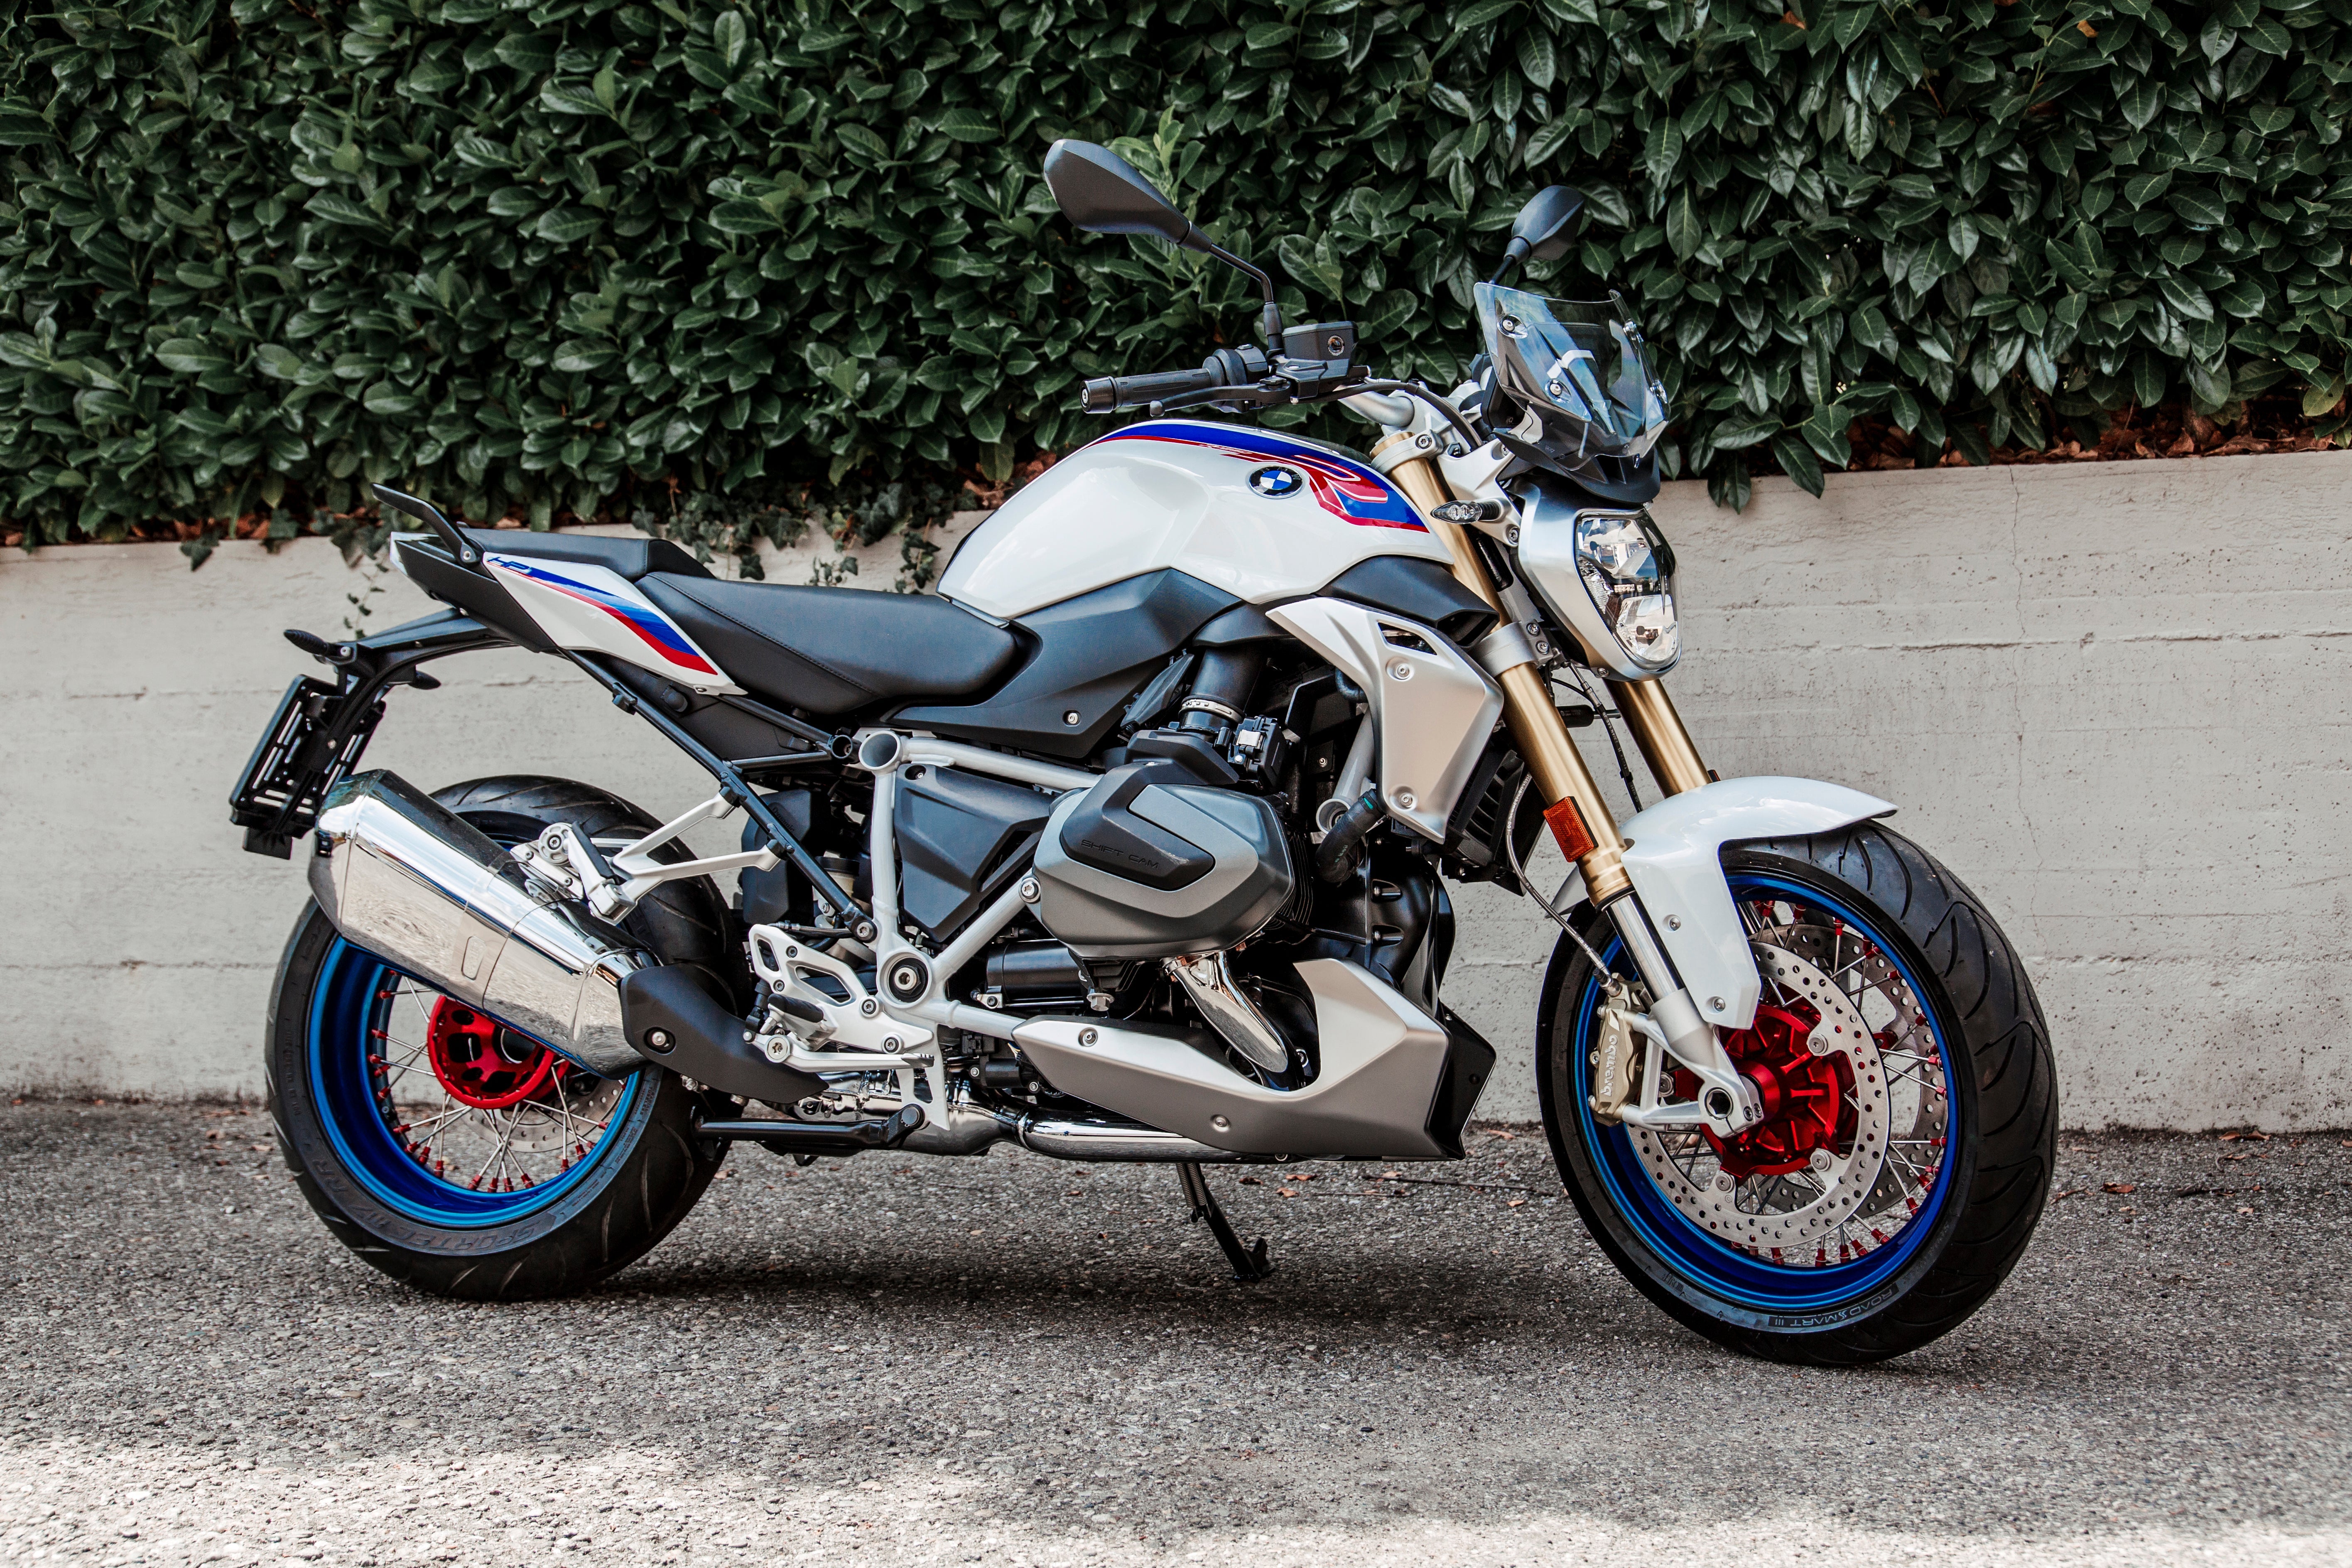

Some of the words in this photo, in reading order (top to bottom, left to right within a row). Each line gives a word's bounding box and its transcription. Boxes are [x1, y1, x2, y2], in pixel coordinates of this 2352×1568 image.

[1261, 466, 1301, 481] BMW
[1081, 839, 1124, 856] SHIFT
[1128, 854, 1160, 869] CAM
[1600, 1034, 1618, 1097] brembo
[312, 1158, 350, 1193] RR
[392, 1222, 537, 1251] SPORTEC
[1789, 1288, 1893, 1327] ROADSMART
